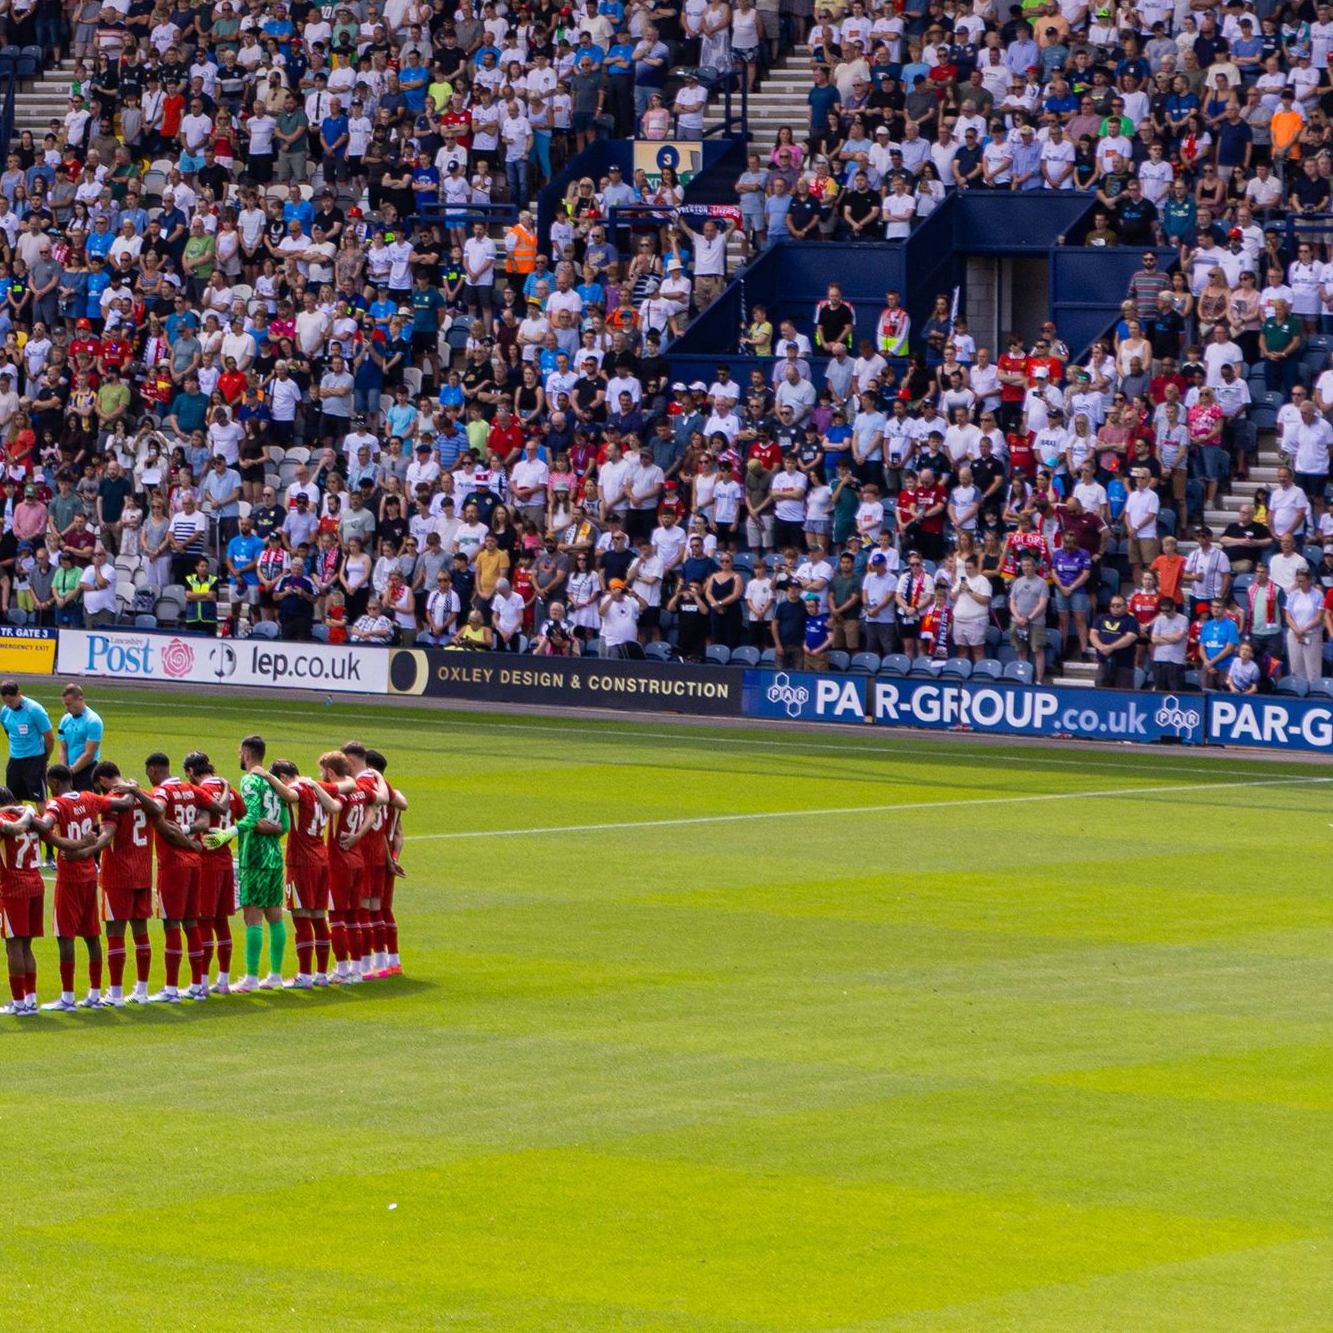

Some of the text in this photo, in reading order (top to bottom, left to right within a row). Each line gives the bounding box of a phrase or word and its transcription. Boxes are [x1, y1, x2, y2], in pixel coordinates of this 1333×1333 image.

[663, 154, 672, 166] 3
[15, 628, 40, 638] GATE
[42, 629, 49, 638] 3
[85, 634, 154, 675] Post
[251, 646, 362, 682] lep.co.uk
[438, 666, 730, 699] OXLEY DESIGN & CONSTRUCTION
[1212, 700, 1333, 747] PAR-G
